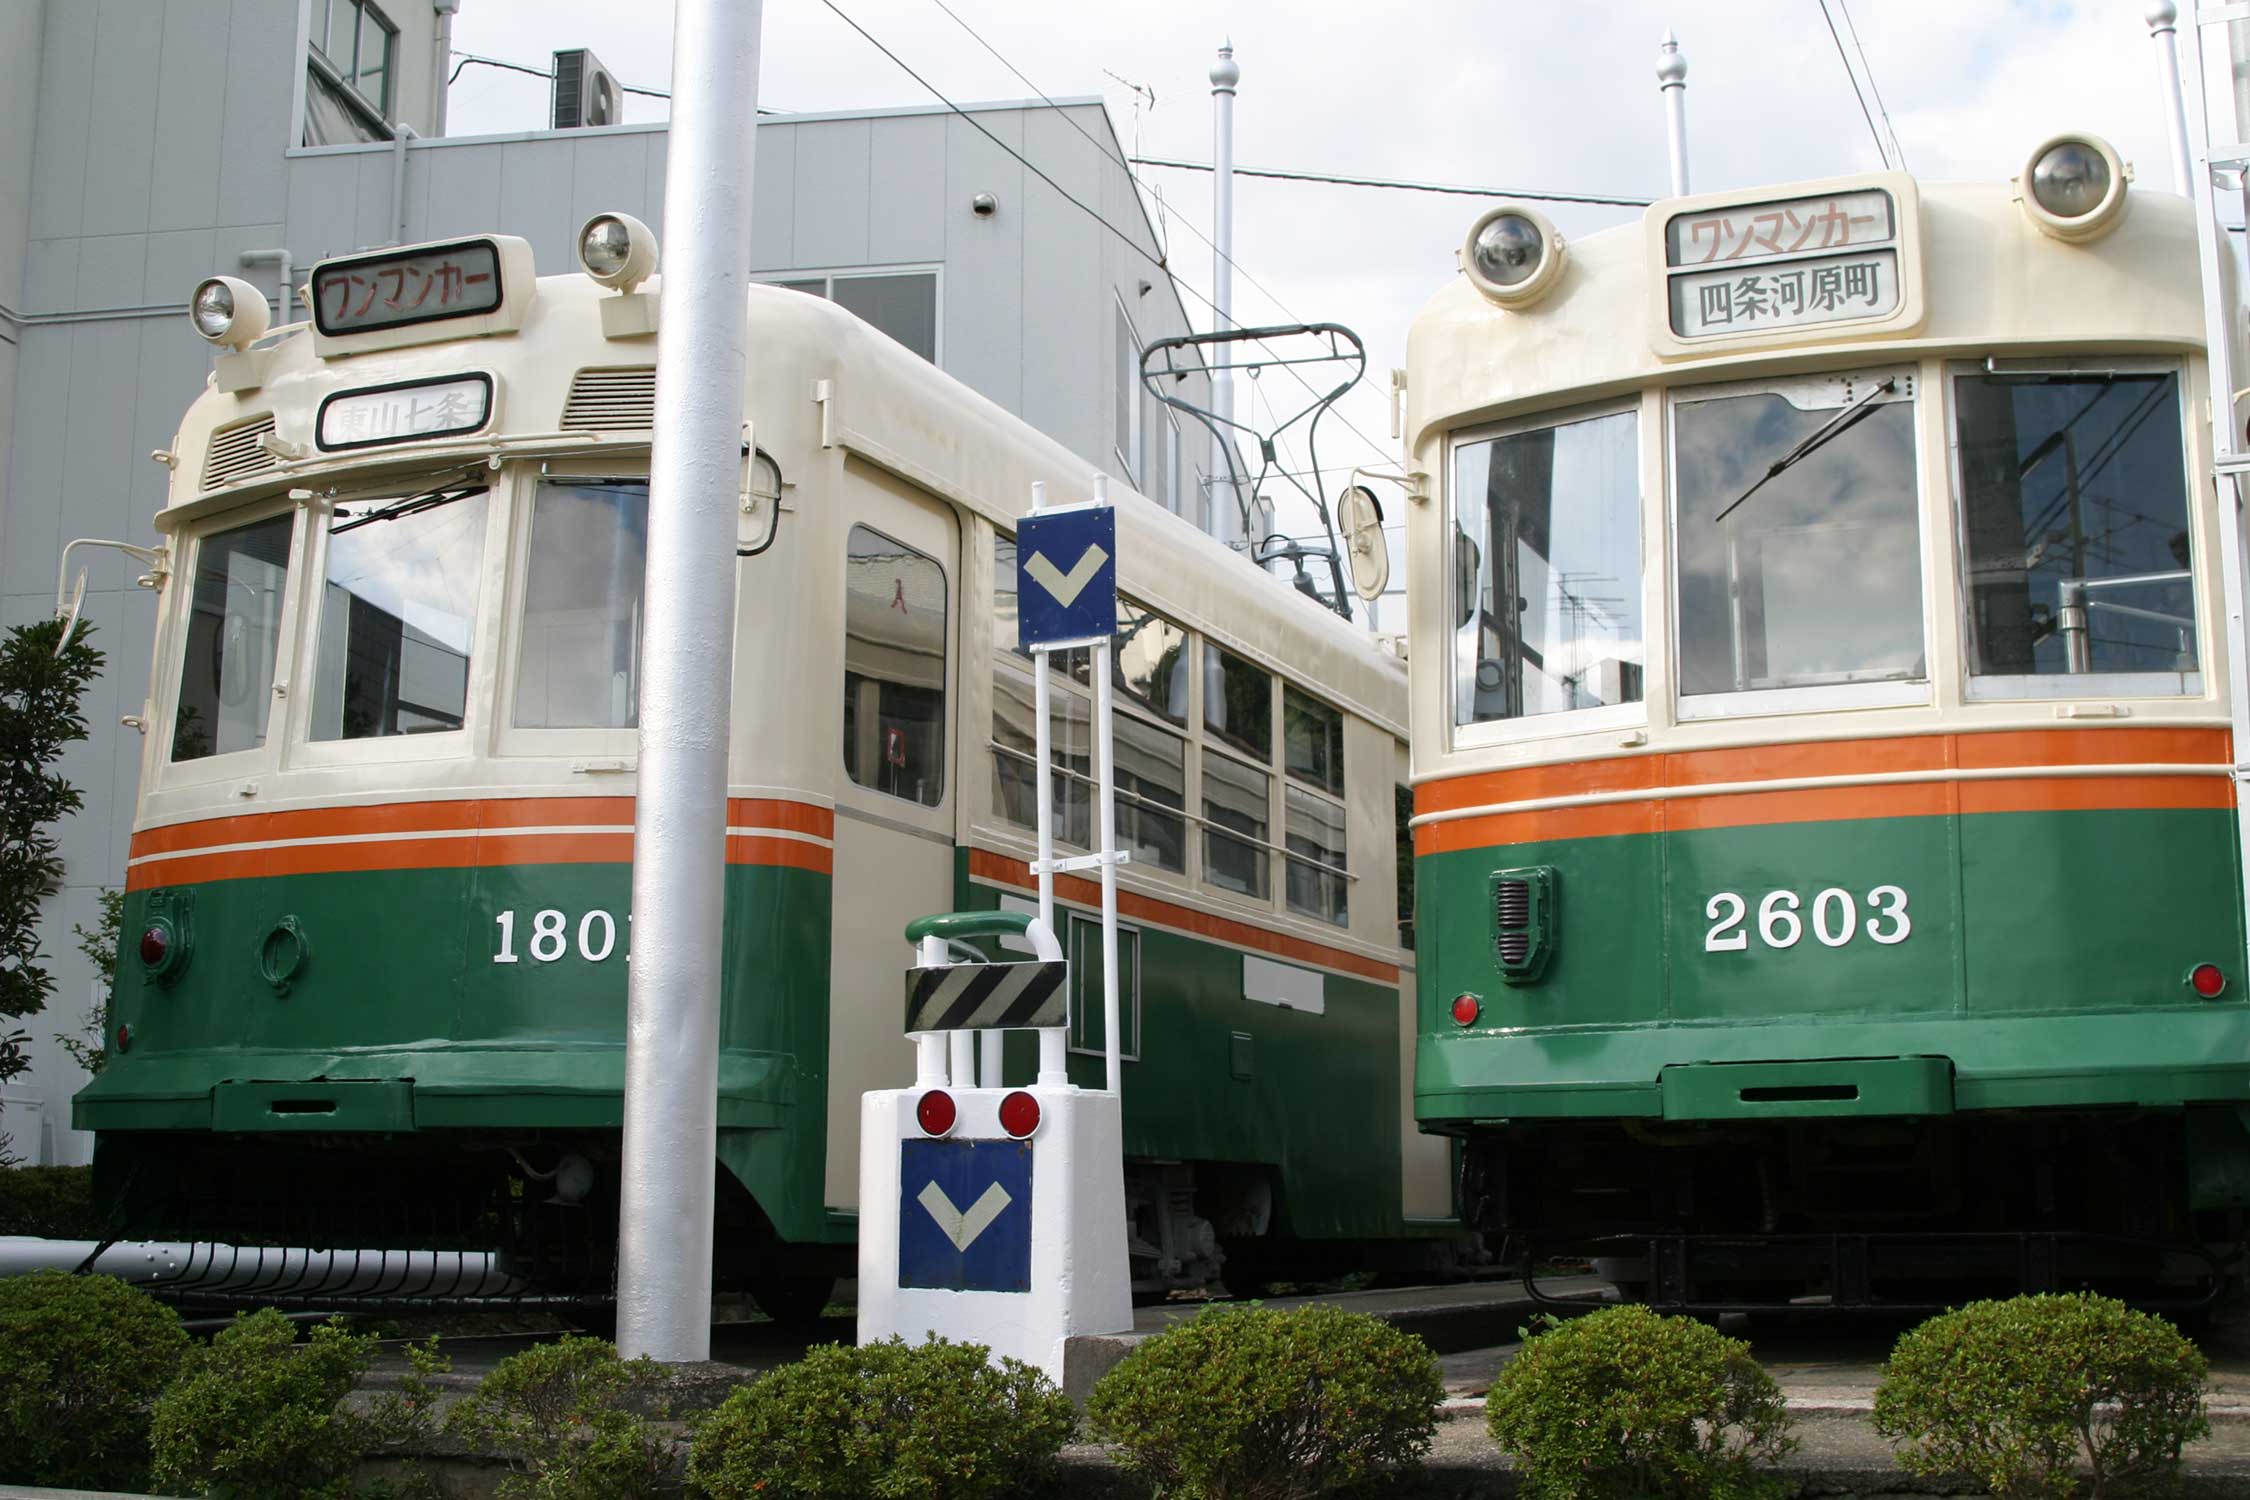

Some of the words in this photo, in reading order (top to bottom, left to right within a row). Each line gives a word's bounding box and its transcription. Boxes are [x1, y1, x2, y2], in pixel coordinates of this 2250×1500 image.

[1691, 202, 1875, 262] ワンマンカー
[320, 261, 490, 320] ワンマンカー
[1699, 262, 1880, 327] 四条河原町
[341, 392, 468, 438] 東山七条
[493, 909, 632, 963] 180
[1705, 885, 1912, 952] 2603
